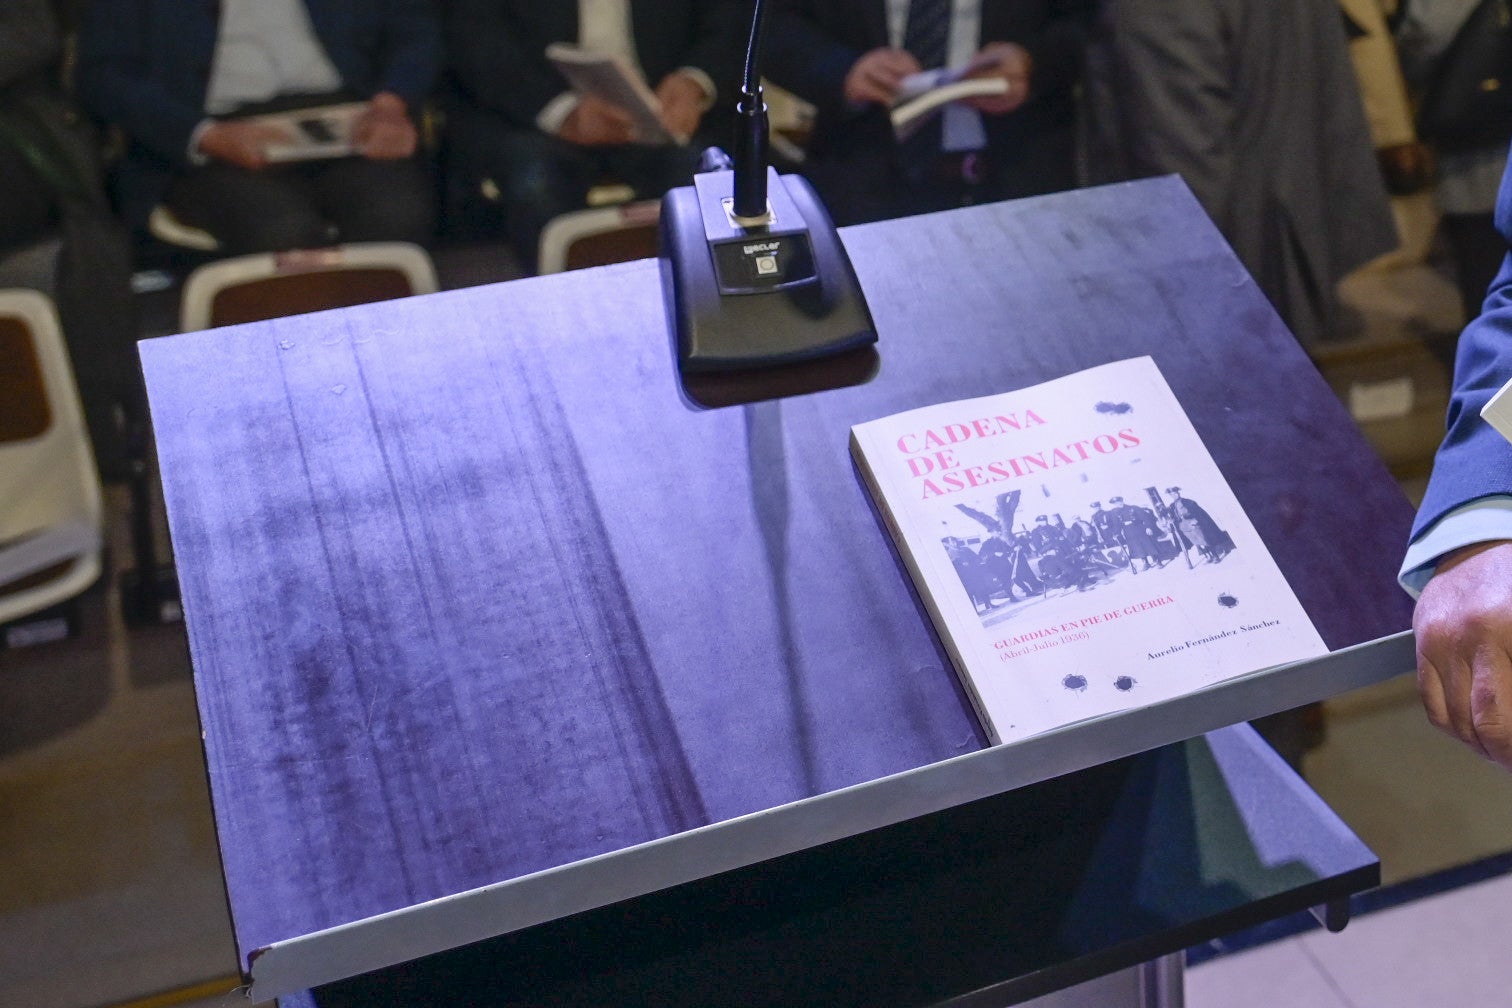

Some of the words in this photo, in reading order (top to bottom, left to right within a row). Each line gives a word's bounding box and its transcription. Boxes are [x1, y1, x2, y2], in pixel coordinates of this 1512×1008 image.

[897, 409, 1048, 454] CADENA
[906, 449, 960, 478] DE
[922, 428, 1141, 499] ASESINATOS
[994, 625, 1059, 650] GUARDIAS
[1062, 621, 1080, 633] EN
[1080, 614, 1103, 627] PIE
[1103, 608, 1123, 622] DE
[1124, 595, 1175, 616] GUERRA
[1147, 643, 1185, 660] Aurelio
[1185, 628, 1238, 649] Fernández
[1240, 619, 1281, 633] Sánchez
